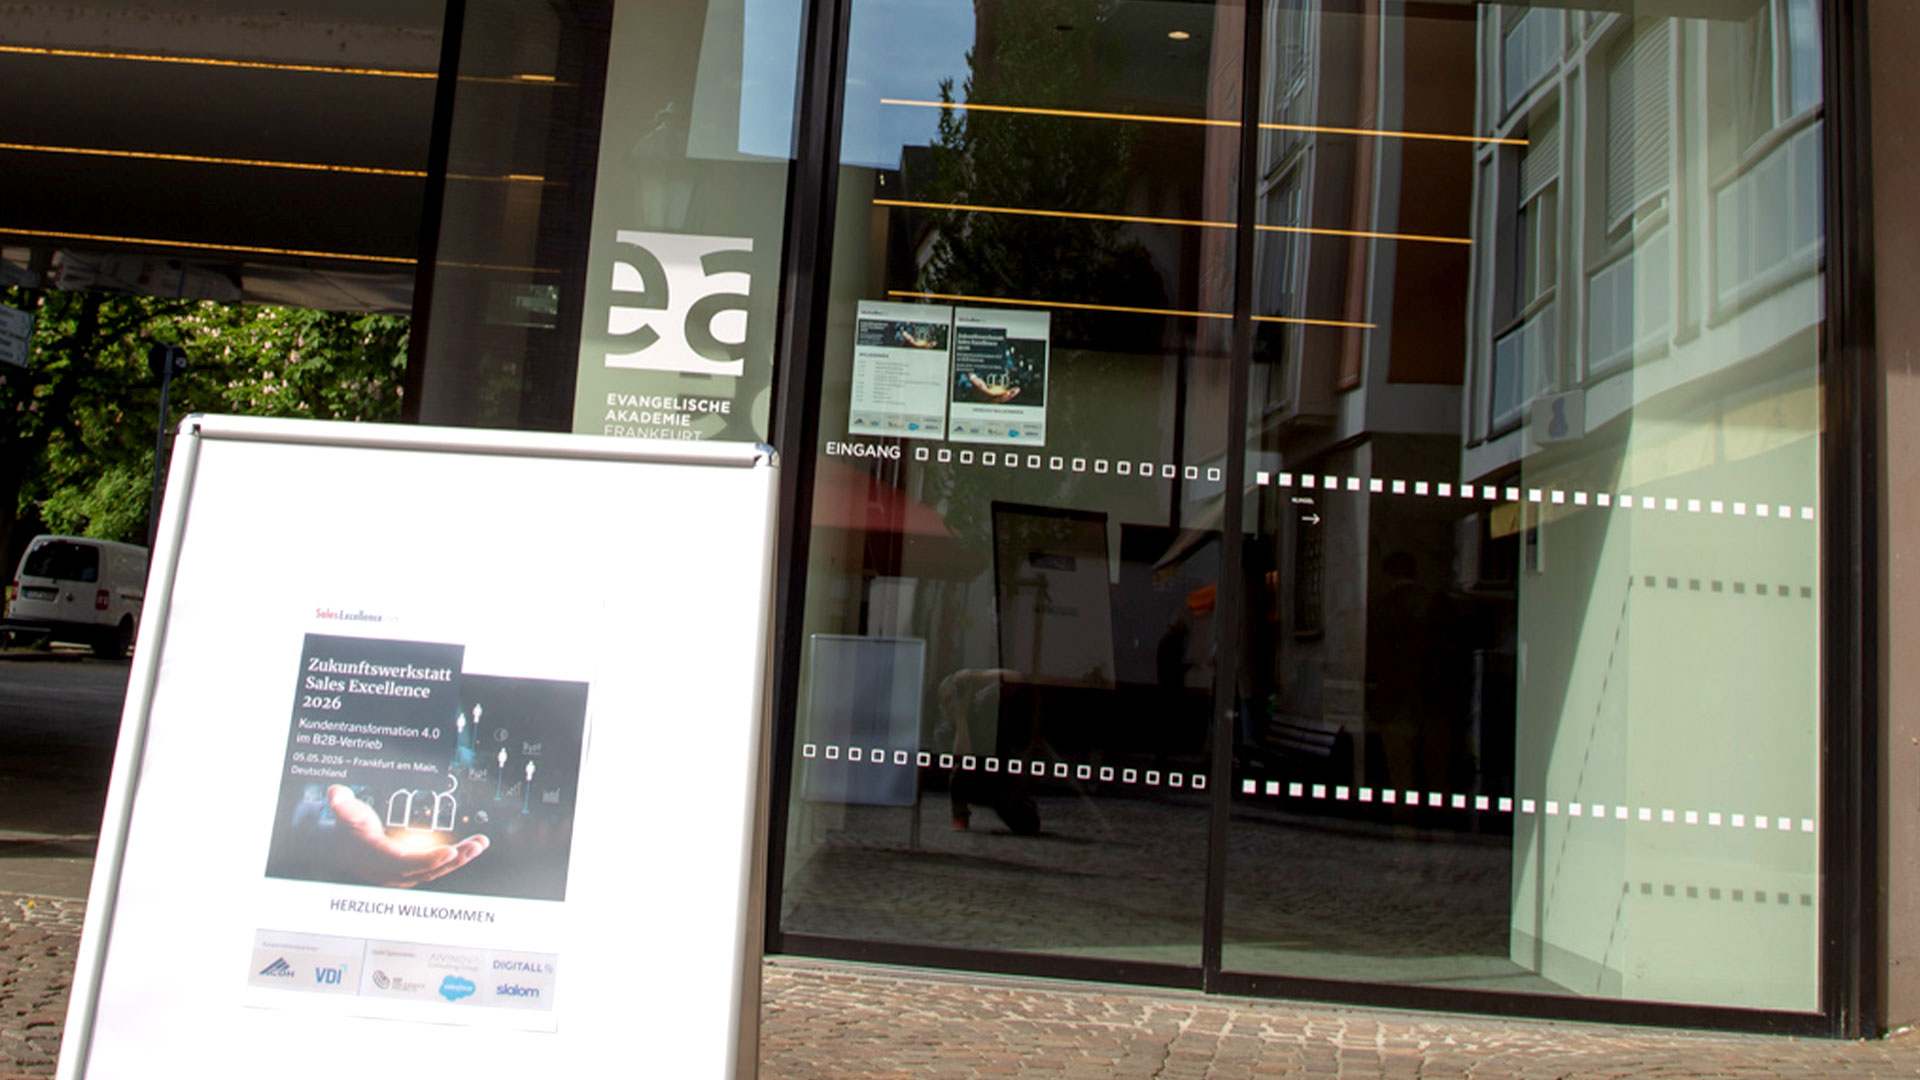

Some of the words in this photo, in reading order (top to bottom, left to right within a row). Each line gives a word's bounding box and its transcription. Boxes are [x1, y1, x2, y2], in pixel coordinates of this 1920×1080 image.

[606, 393, 730, 414] EVANGELISCHE
[605, 409, 691, 426] AKADEMIE
[604, 425, 702, 441] FRANKFURT
[826, 441, 901, 460] EINGANG
[307, 657, 452, 682] Zukunftswerkstatt
[305, 676, 345, 693] Sales
[348, 679, 430, 698] Excellence
[302, 696, 342, 711] 2026
[298, 718, 420, 738] Kundentransformation
[421, 727, 440, 740] 4.0
[296, 733, 310, 745] im
[313, 733, 383, 750] B2B-Vertrieb
[290, 765, 347, 779] Deutschland
[292, 751, 343, 765] 05.05.2026
[353, 756, 396, 771] Frankfurt
[397, 762, 411, 772] am
[412, 761, 439, 774] Main,
[330, 898, 394, 916] HERZLICH
[398, 904, 495, 923] WILLKOMMEN
[315, 966, 342, 985] VDI
[493, 959, 543, 973] DIGITALL
[496, 983, 540, 999] slalom
